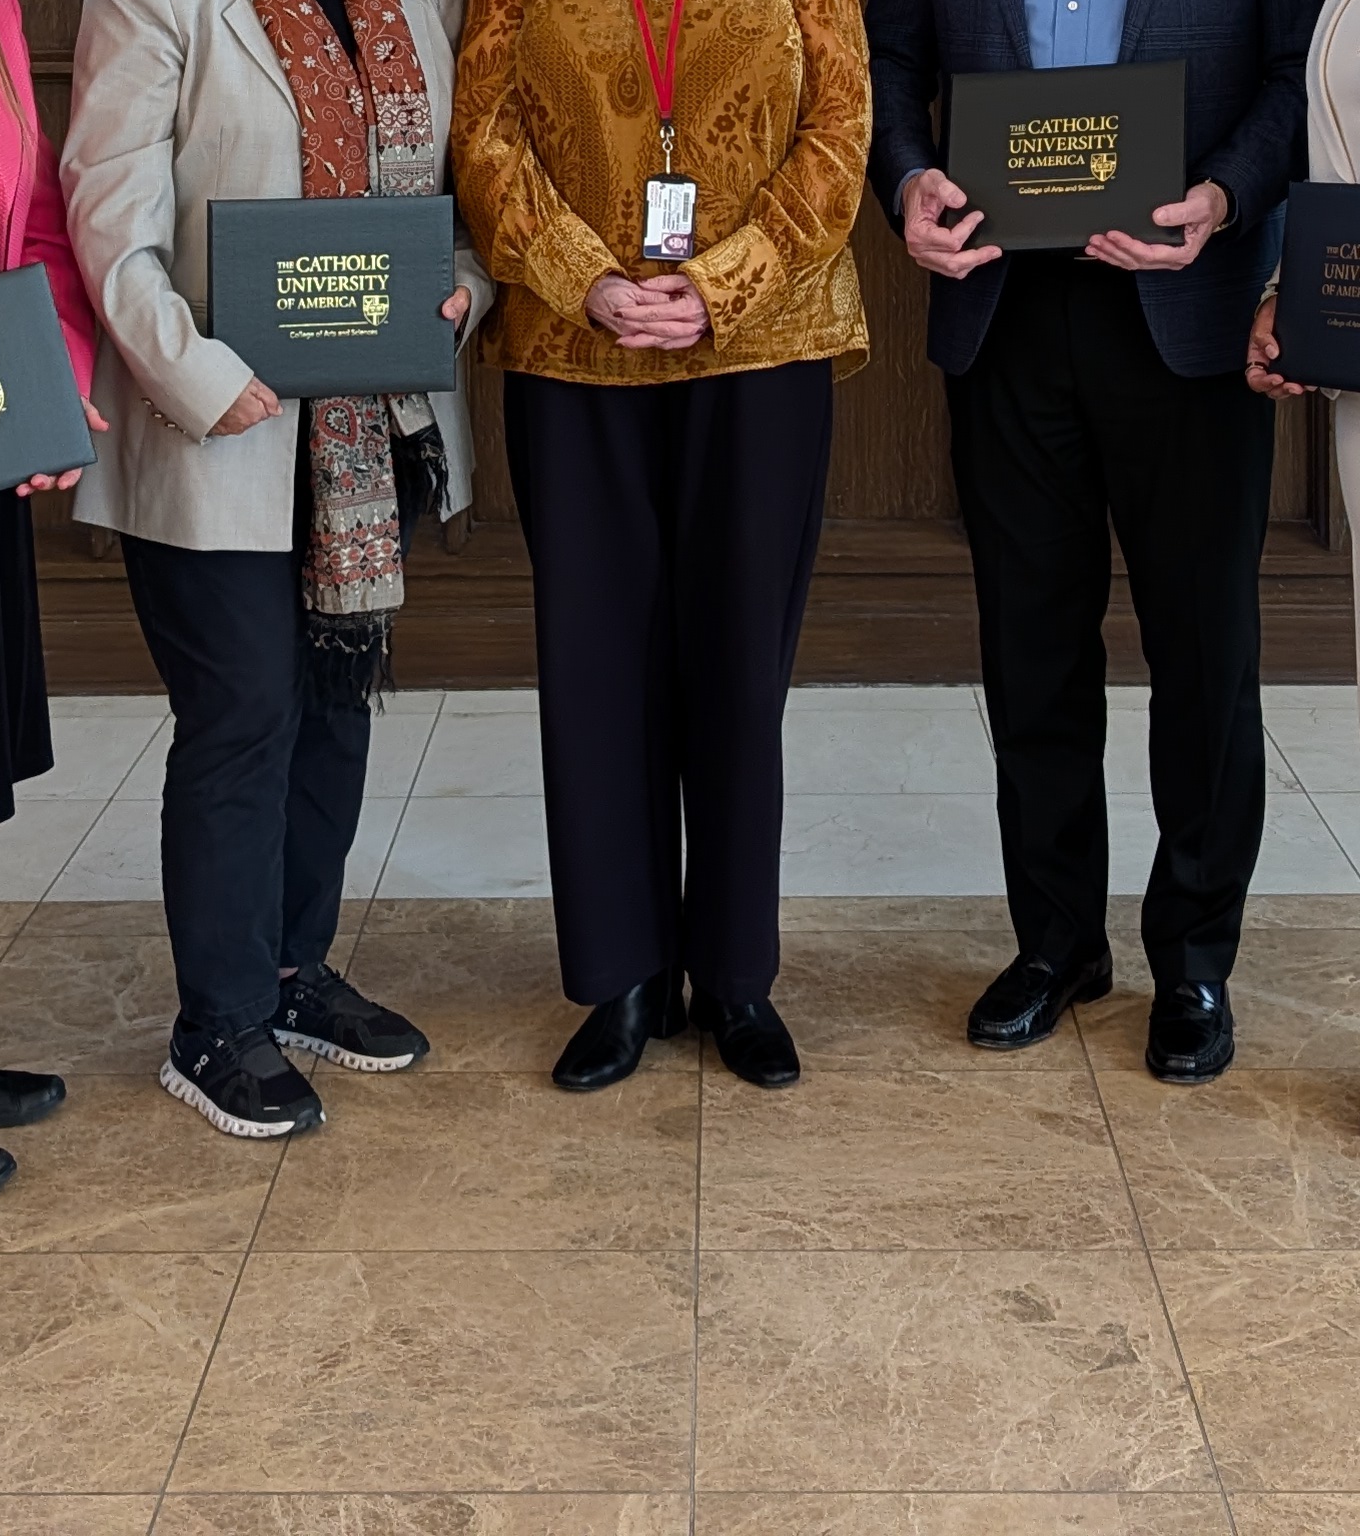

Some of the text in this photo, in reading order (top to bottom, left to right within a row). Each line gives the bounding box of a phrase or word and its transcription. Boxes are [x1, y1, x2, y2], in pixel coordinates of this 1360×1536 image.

[1009, 115, 1119, 135] THE CATHOLIC
[1009, 133, 1118, 154] UNIVERSITY
[1008, 154, 1086, 169] OF AMERICA
[276, 253, 390, 273] THE CATHOLIC
[276, 274, 390, 294] UNIVERSITY
[1321, 284, 1336, 296] OF
[276, 296, 358, 311] OF AMERICA
